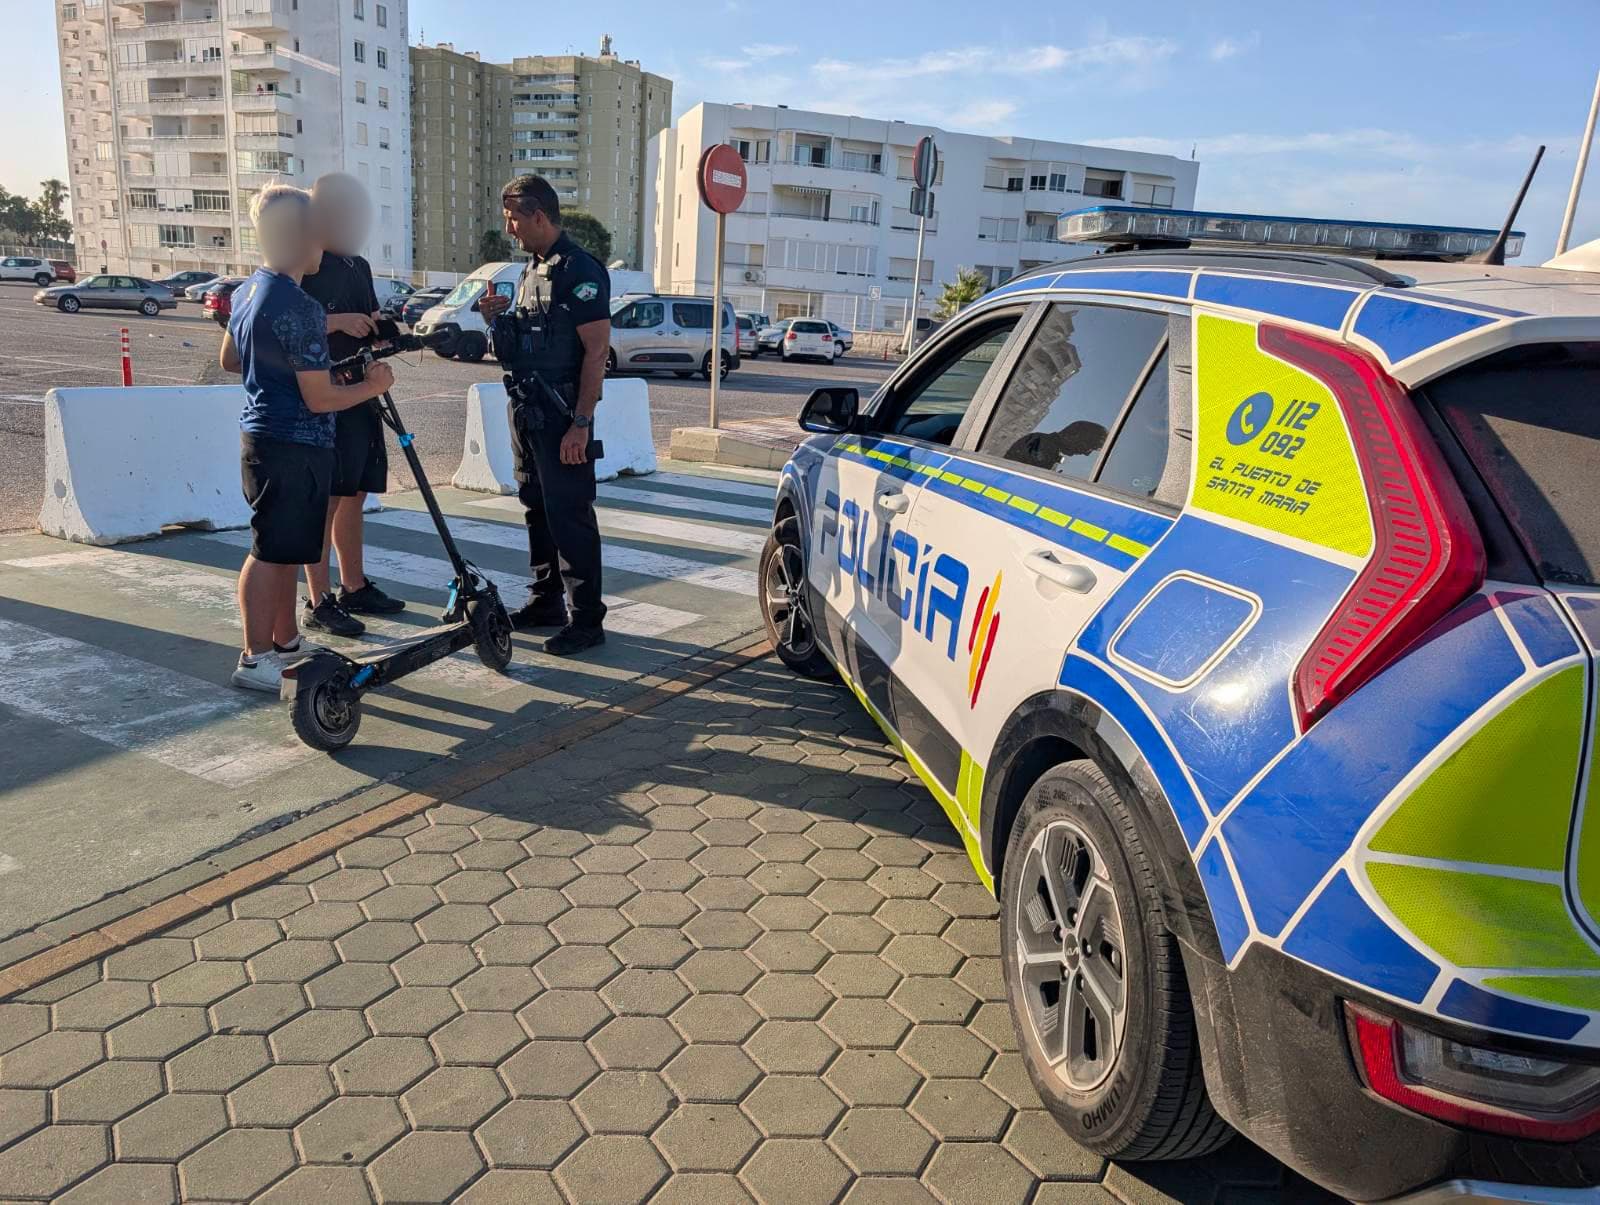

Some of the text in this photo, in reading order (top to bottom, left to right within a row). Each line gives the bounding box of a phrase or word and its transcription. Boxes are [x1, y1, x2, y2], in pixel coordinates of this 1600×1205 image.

[1277, 399, 1321, 430] 112
[1260, 431, 1306, 459] 092
[1206, 475, 1256, 498] SANTA
[1210, 457, 1322, 495] EL PUERTO DE
[821, 489, 969, 661] POLICÍA
[1082, 1070, 1127, 1130] KUMHO
